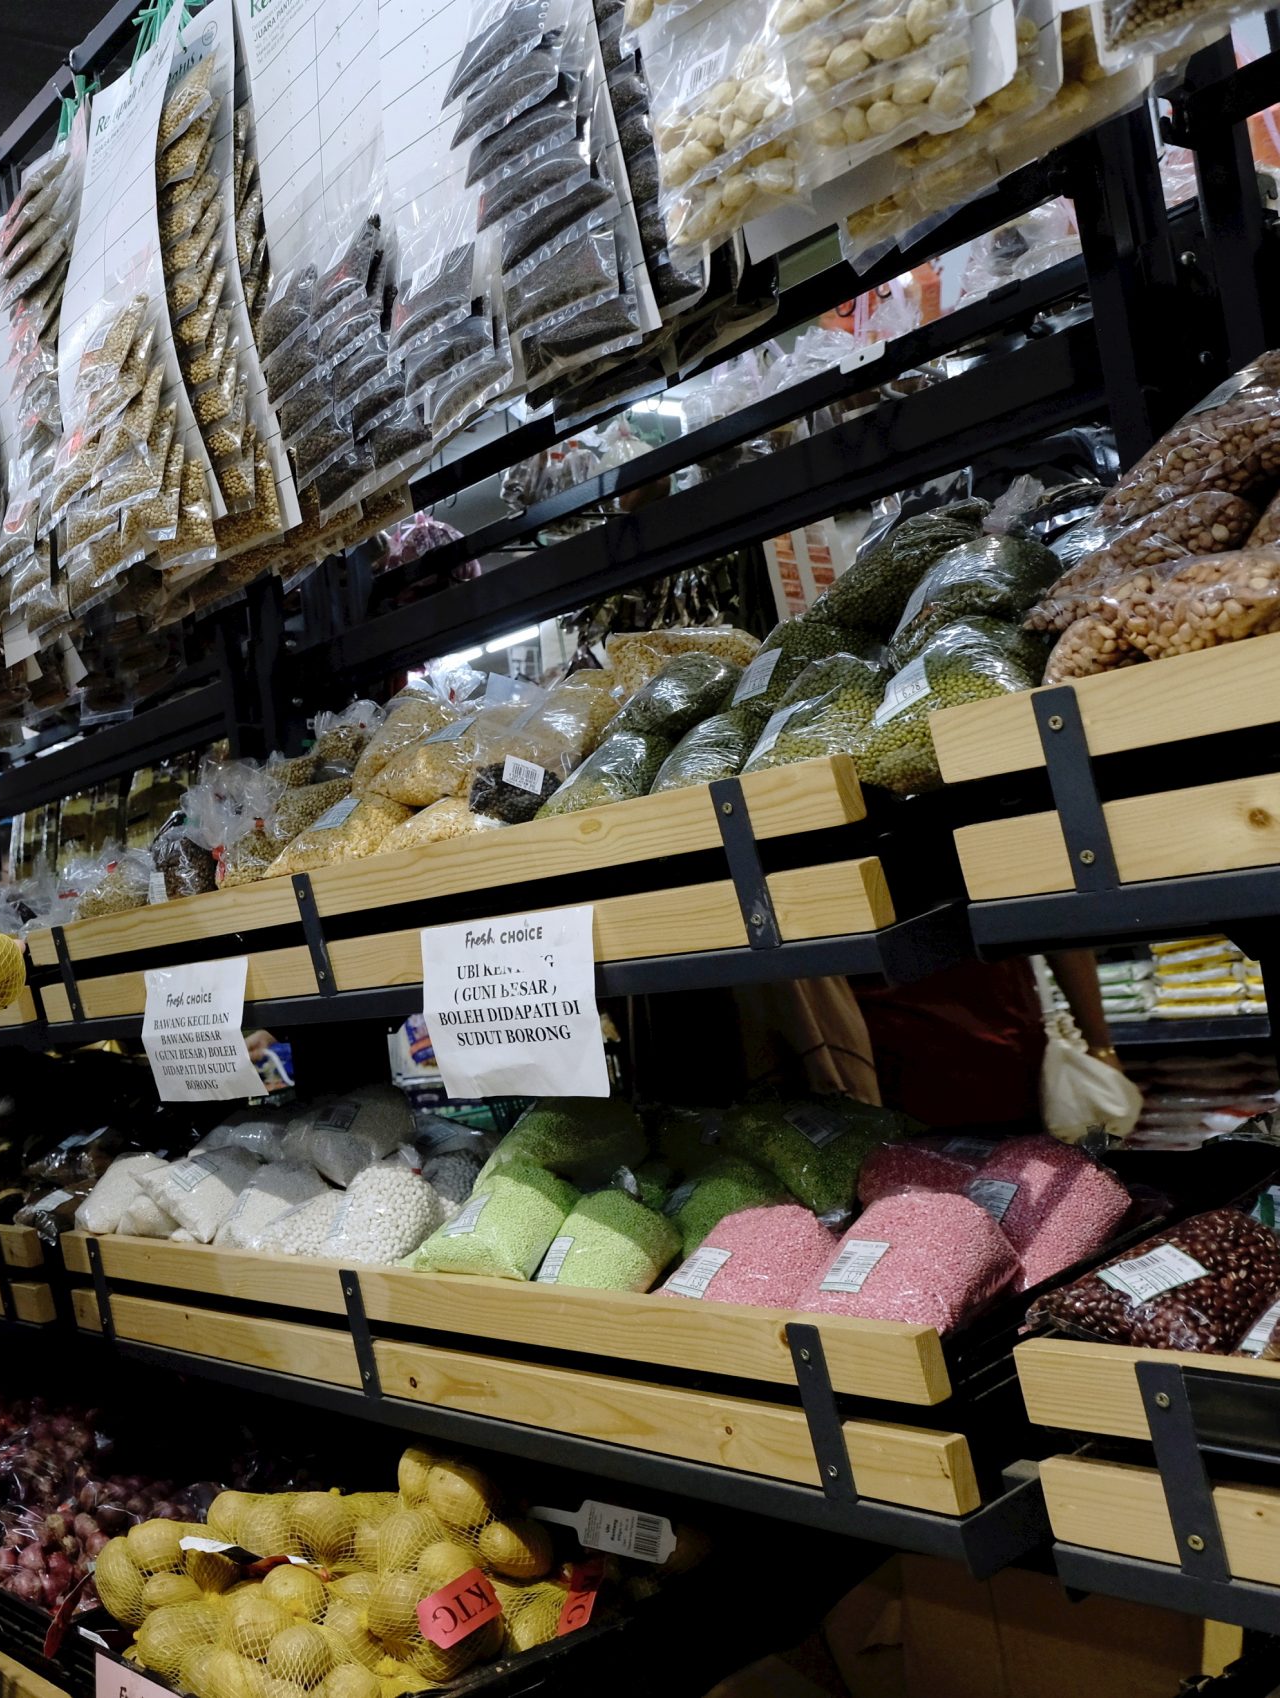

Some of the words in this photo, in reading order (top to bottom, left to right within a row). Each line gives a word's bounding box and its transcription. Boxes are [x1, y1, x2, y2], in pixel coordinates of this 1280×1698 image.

[465, 928, 495, 949] Fresh
[500, 926, 543, 944] CHOICE
[457, 964, 480, 980] UBI
[166, 992, 184, 1007] Fresh
[186, 993, 212, 1005] CHOICE
[154, 1017, 186, 1030] BAWANG
[187, 1015, 211, 1027] KECIL
[212, 1012, 230, 1025] DAN
[439, 1008, 485, 1026] BOLEH
[488, 1001, 558, 1022] DIDAPATI
[562, 1000, 581, 1016] DI
[161, 1032, 194, 1045] BAWANG
[195, 1030, 222, 1042] BESAR
[457, 1030, 502, 1047] SUDUT
[506, 1025, 571, 1044] BORONG
[208, 1045, 237, 1058] BOLEH
[162, 1064, 196, 1076] DIDAPATI
[197, 1064, 207, 1075] DI
[208, 1062, 237, 1074] SUDUT
[185, 1079, 219, 1091] BORONG
[432, 1581, 495, 1635] KTG
